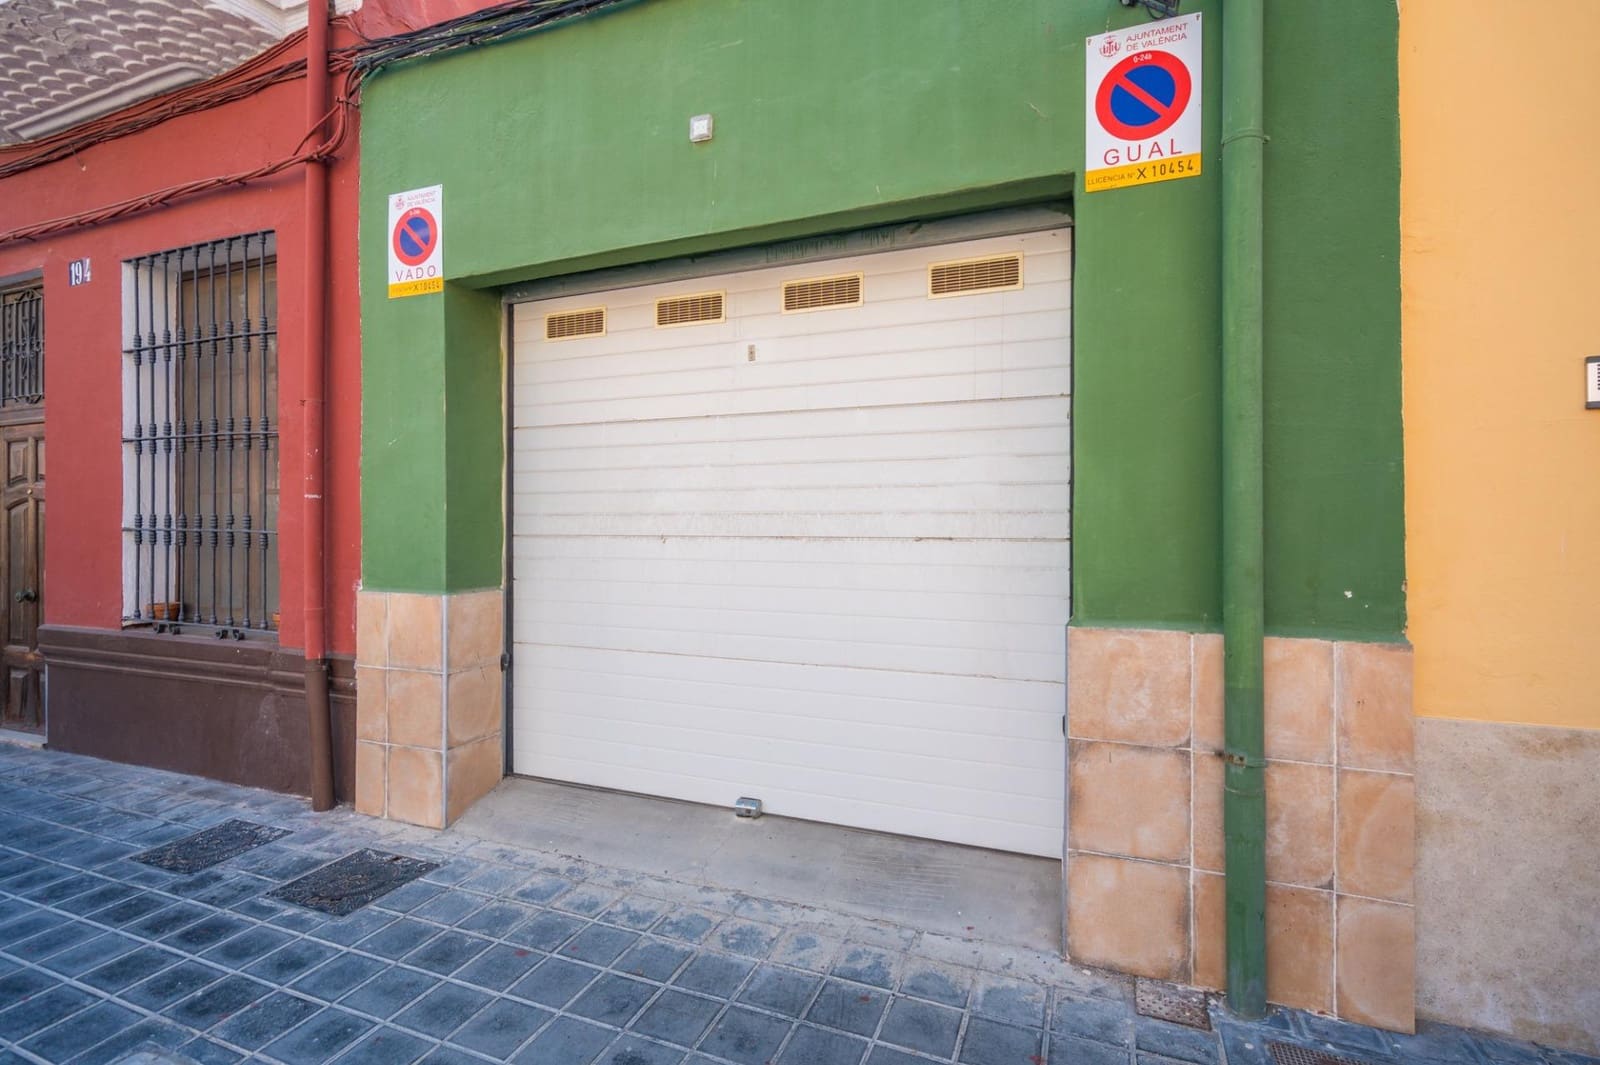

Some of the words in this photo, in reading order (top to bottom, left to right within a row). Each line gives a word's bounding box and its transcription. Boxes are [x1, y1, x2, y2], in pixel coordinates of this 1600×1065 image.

[1126, 22, 1188, 42] AJUNTAMENT
[1126, 42, 1139, 52] DE
[1103, 138, 1183, 166] GUAL
[70, 258, 91, 286] 194
[395, 264, 436, 282] VADO
